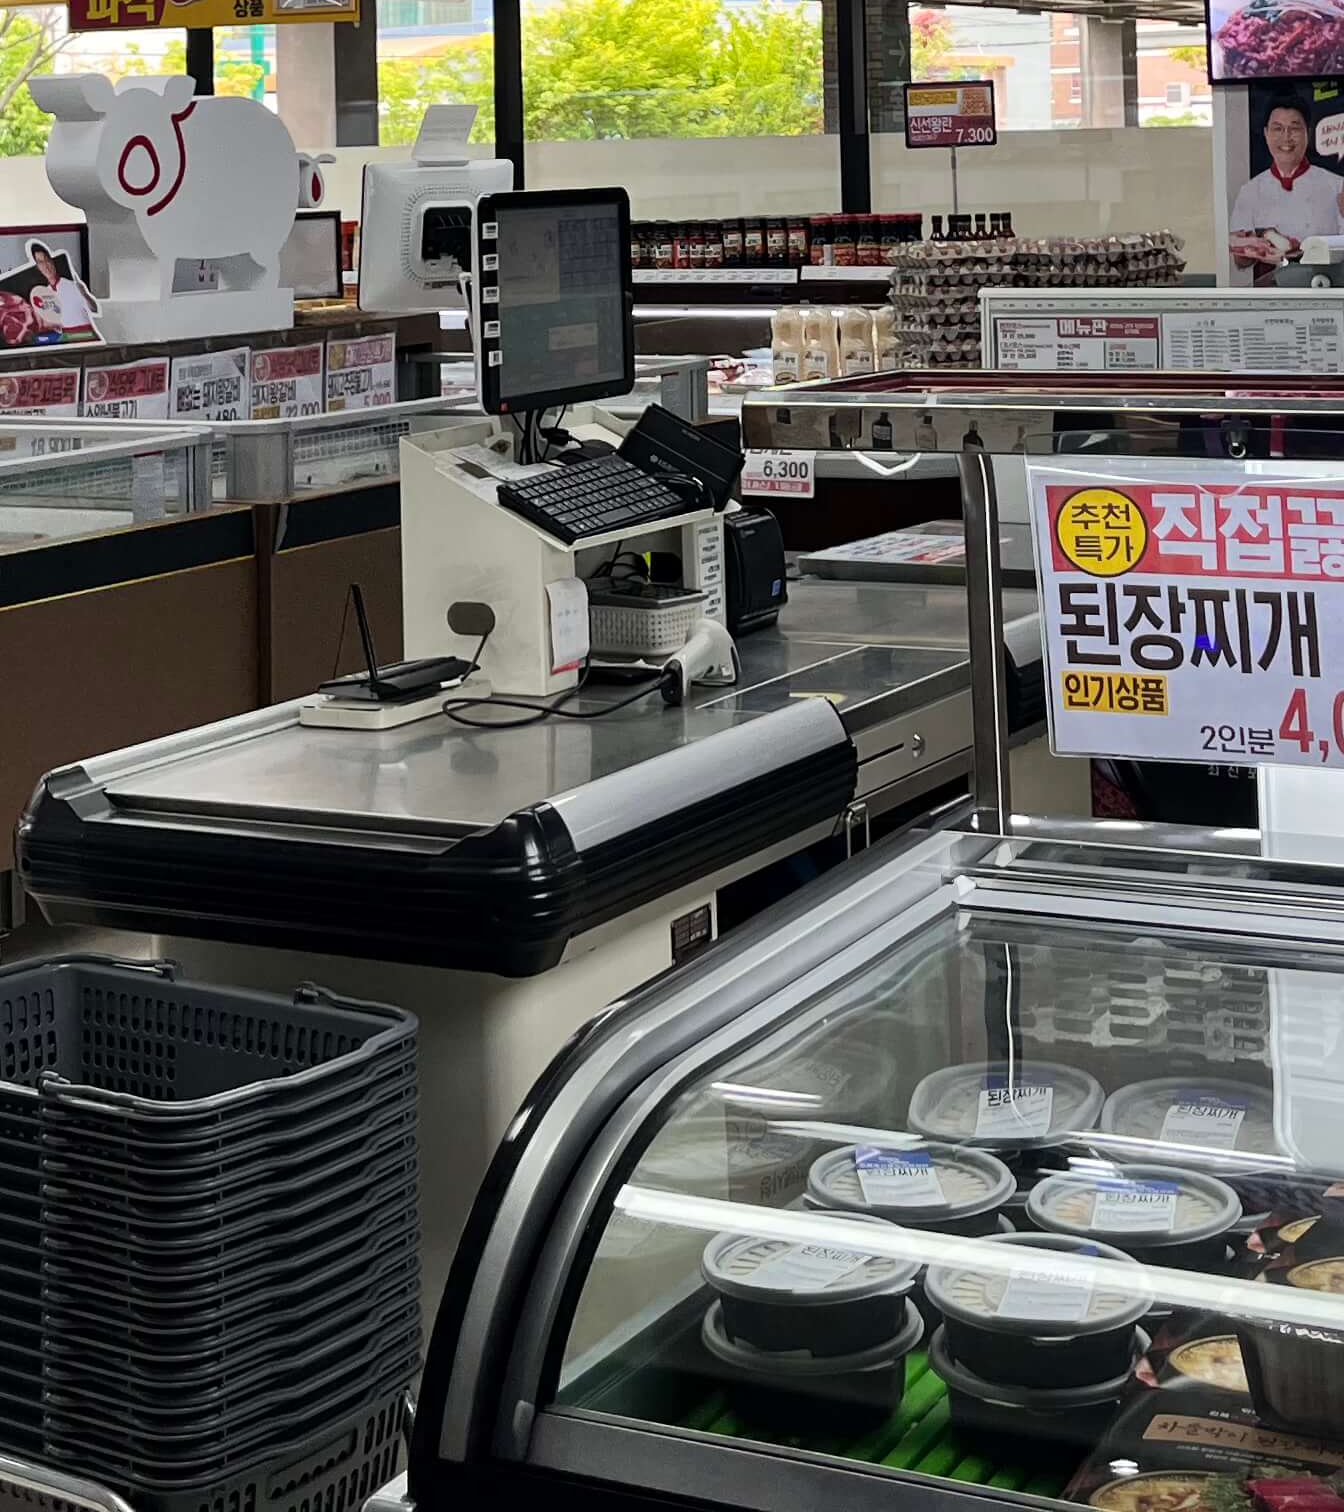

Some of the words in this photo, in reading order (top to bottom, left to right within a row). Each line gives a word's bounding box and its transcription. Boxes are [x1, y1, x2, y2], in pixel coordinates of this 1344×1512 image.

[910, 117, 953, 135] 신선왕란
[1059, 319, 1106, 336] 메뉴판
[763, 460, 808, 478] 6,300
[1070, 502, 1131, 531] 추천
[1074, 535, 1134, 563] 특가
[1058, 582, 1322, 679] 된장찌개
[1064, 672, 1166, 713] 인기상품
[1199, 724, 1276, 756] 2인분
[987, 1087, 1046, 1107] 된장찌개
